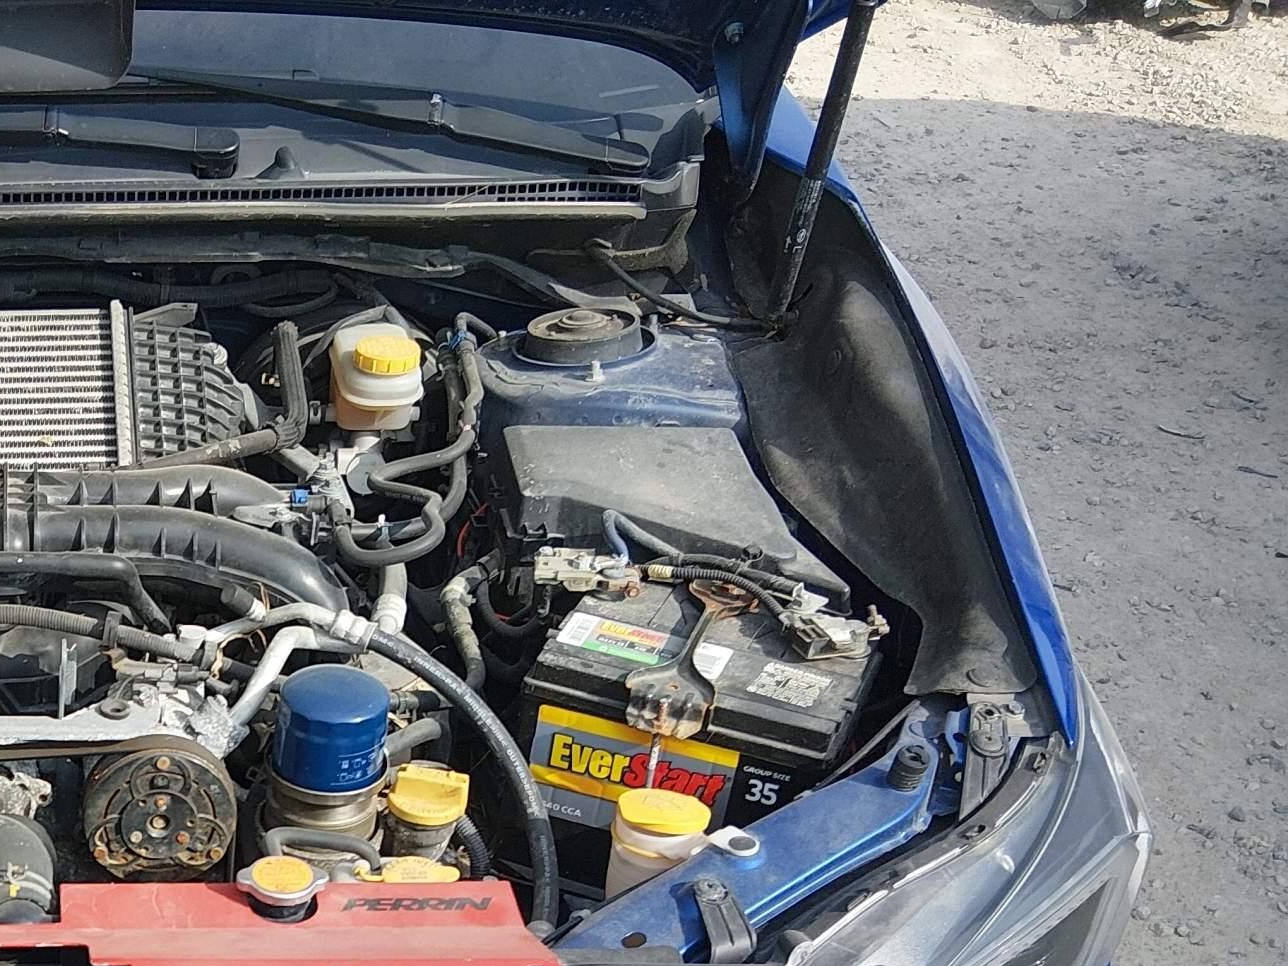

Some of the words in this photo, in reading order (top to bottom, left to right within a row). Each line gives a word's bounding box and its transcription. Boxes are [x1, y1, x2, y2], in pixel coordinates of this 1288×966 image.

[548, 733, 727, 807] EverStart
[743, 765, 772, 776] GROUP
[772, 771, 791, 782] SIZE
[744, 778, 780, 806] 35
[561, 805, 582, 817] CCA
[341, 896, 492, 912] PERRIN
